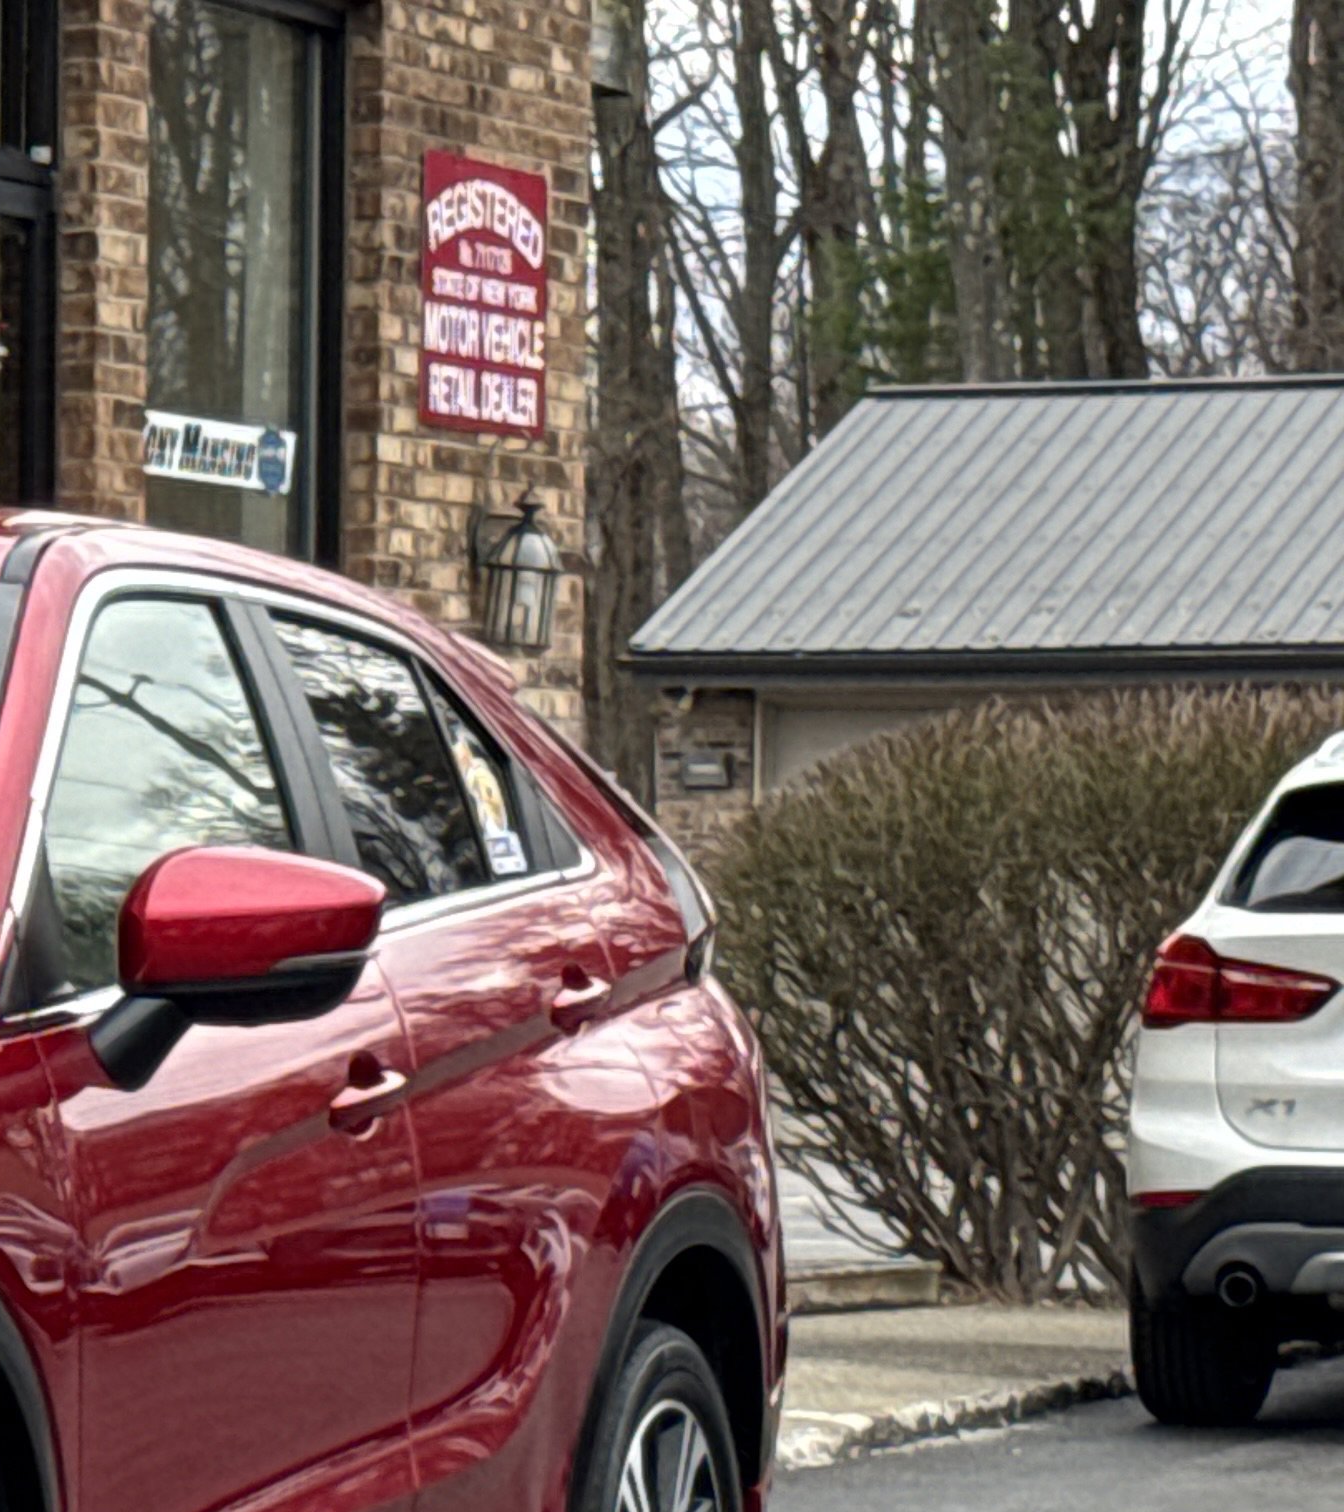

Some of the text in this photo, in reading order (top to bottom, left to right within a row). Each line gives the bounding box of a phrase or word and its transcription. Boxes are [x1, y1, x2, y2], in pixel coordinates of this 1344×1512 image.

[426, 178, 545, 270] REGISTERED
[424, 300, 545, 371] MOTOR VEHICLE
[428, 362, 538, 427] RETAIL DEALER
[144, 423, 180, 470] ONY
